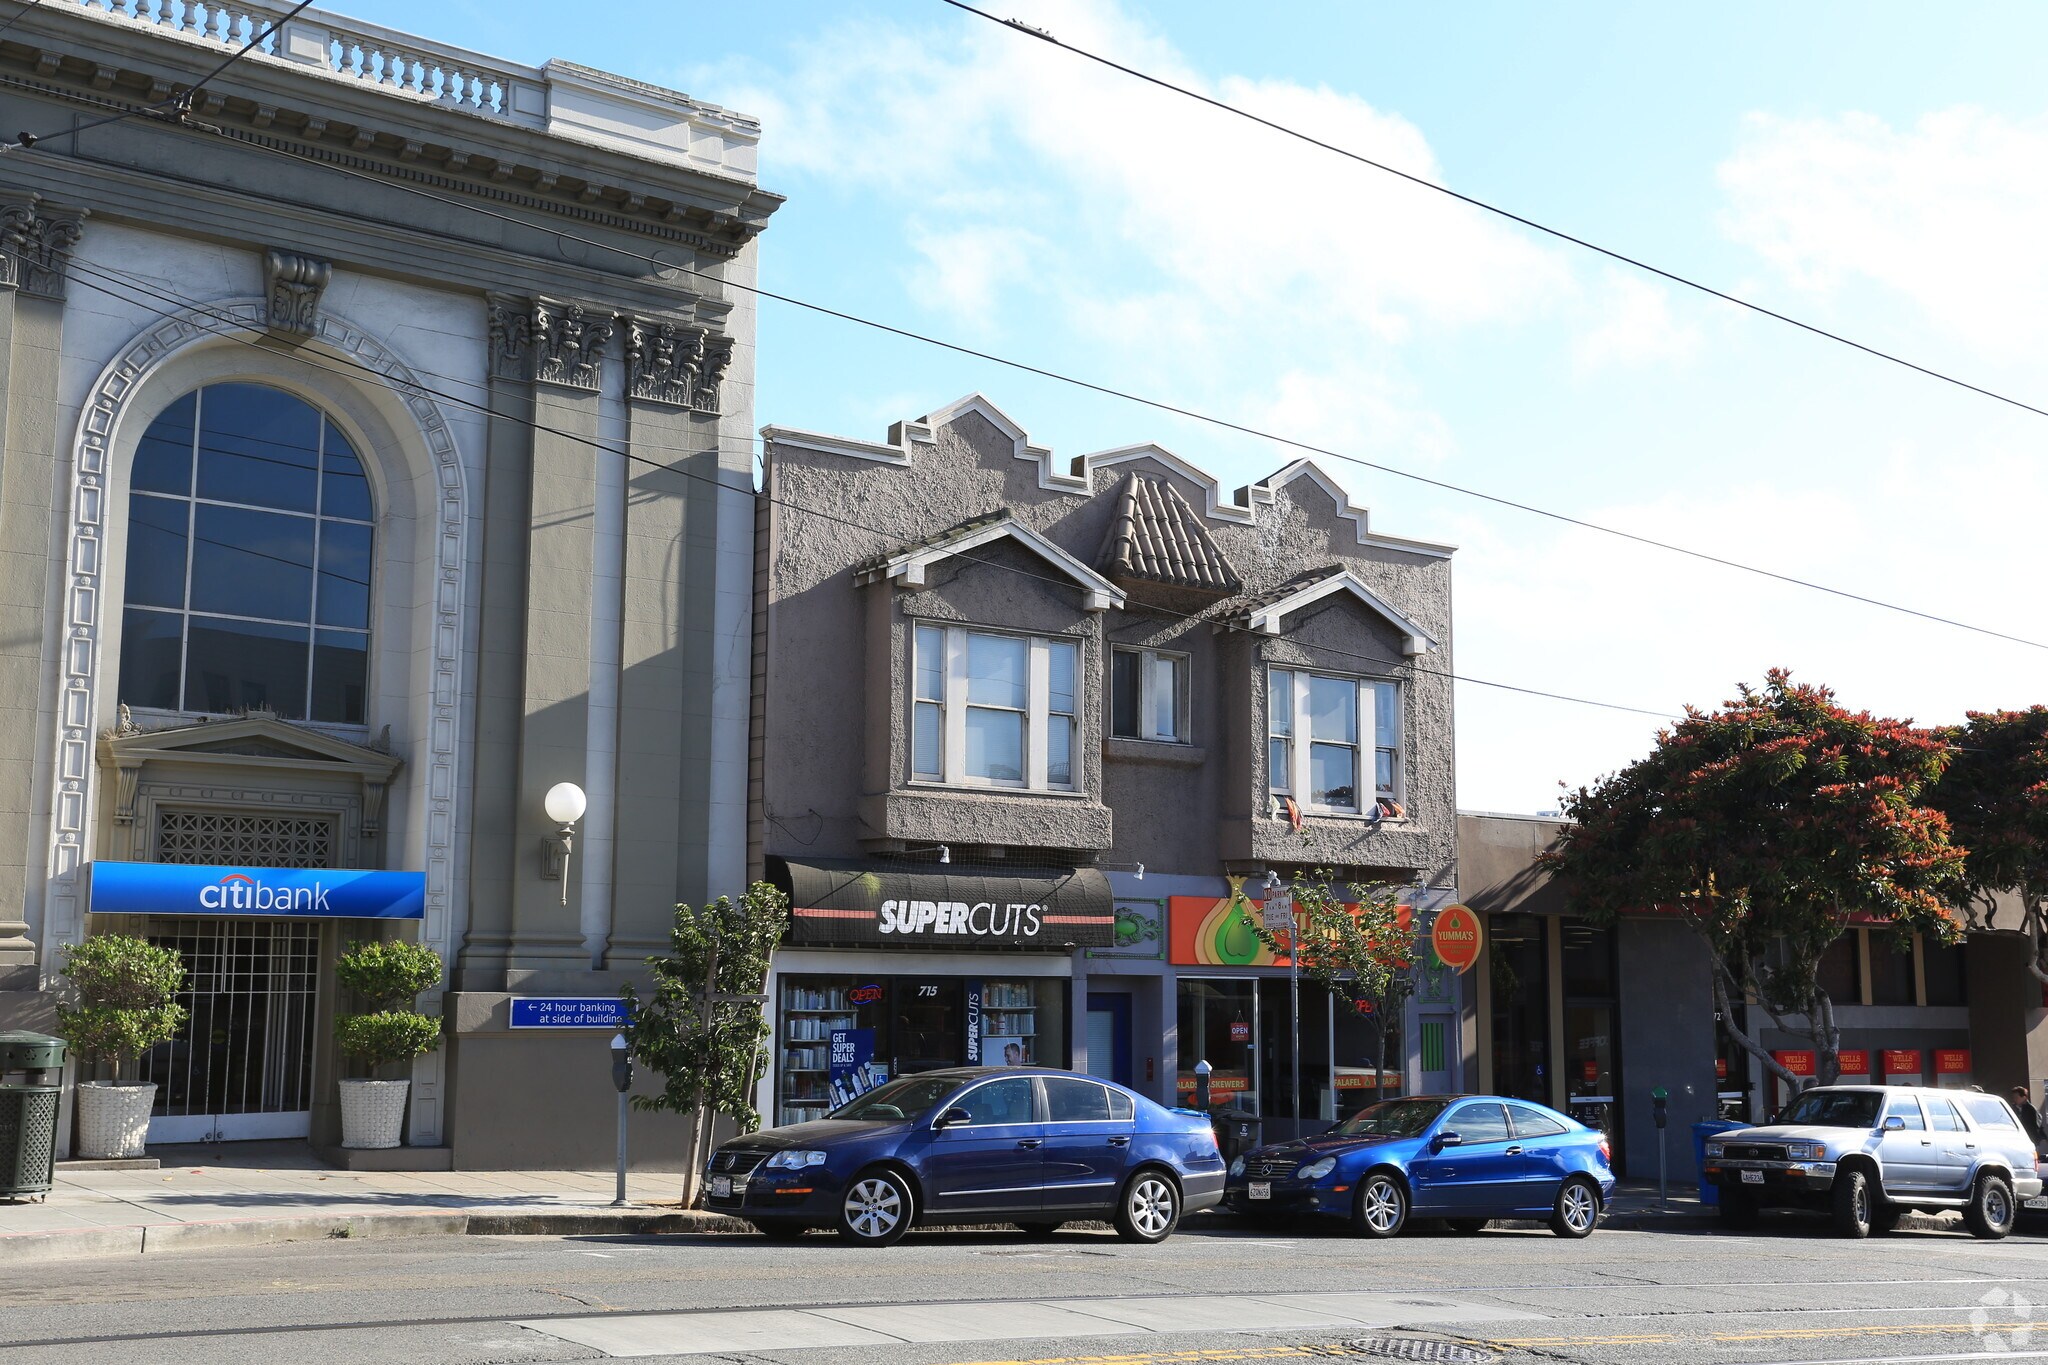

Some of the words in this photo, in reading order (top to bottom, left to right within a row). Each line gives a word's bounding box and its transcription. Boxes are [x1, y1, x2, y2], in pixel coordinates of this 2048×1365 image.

[199, 879, 330, 911] citibank
[1264, 889, 1271, 900] NO
[1272, 889, 1289, 898] PARKIN
[878, 899, 1042, 937] SUPERCUTS
[1437, 930, 1474, 941] YUMMA'S
[850, 987, 883, 1001] OPEN
[918, 985, 938, 997] 715
[540, 1002, 552, 1012] 24
[555, 1002, 577, 1012] hour
[580, 1002, 616, 1014] banking
[539, 1014, 550, 1024] at
[552, 1013, 572, 1024] side
[574, 1013, 584, 1024] of
[1713, 1011, 1723, 1021] 72
[968, 992, 979, 1062] SUPERCUTS
[1231, 1027, 1249, 1035] OPEN
[832, 1032, 847, 1043] GET
[832, 1042, 856, 1053] SUPER
[832, 1052, 855, 1063] DEALS
[1784, 1055, 1807, 1063] WELLS
[1839, 1055, 1861, 1063] WELLS
[1892, 1054, 1913, 1062] WELLS
[1943, 1054, 1964, 1062] WELLS
[1785, 1063, 1807, 1072] FARGO
[1840, 1062, 1861, 1071] FARGO
[1892, 1062, 1914, 1070] FARGO
[1944, 1061, 1964, 1069] FARGO
[1211, 1080, 1245, 1088] SKEWERS
[1333, 1078, 1362, 1087] FALAFEL
